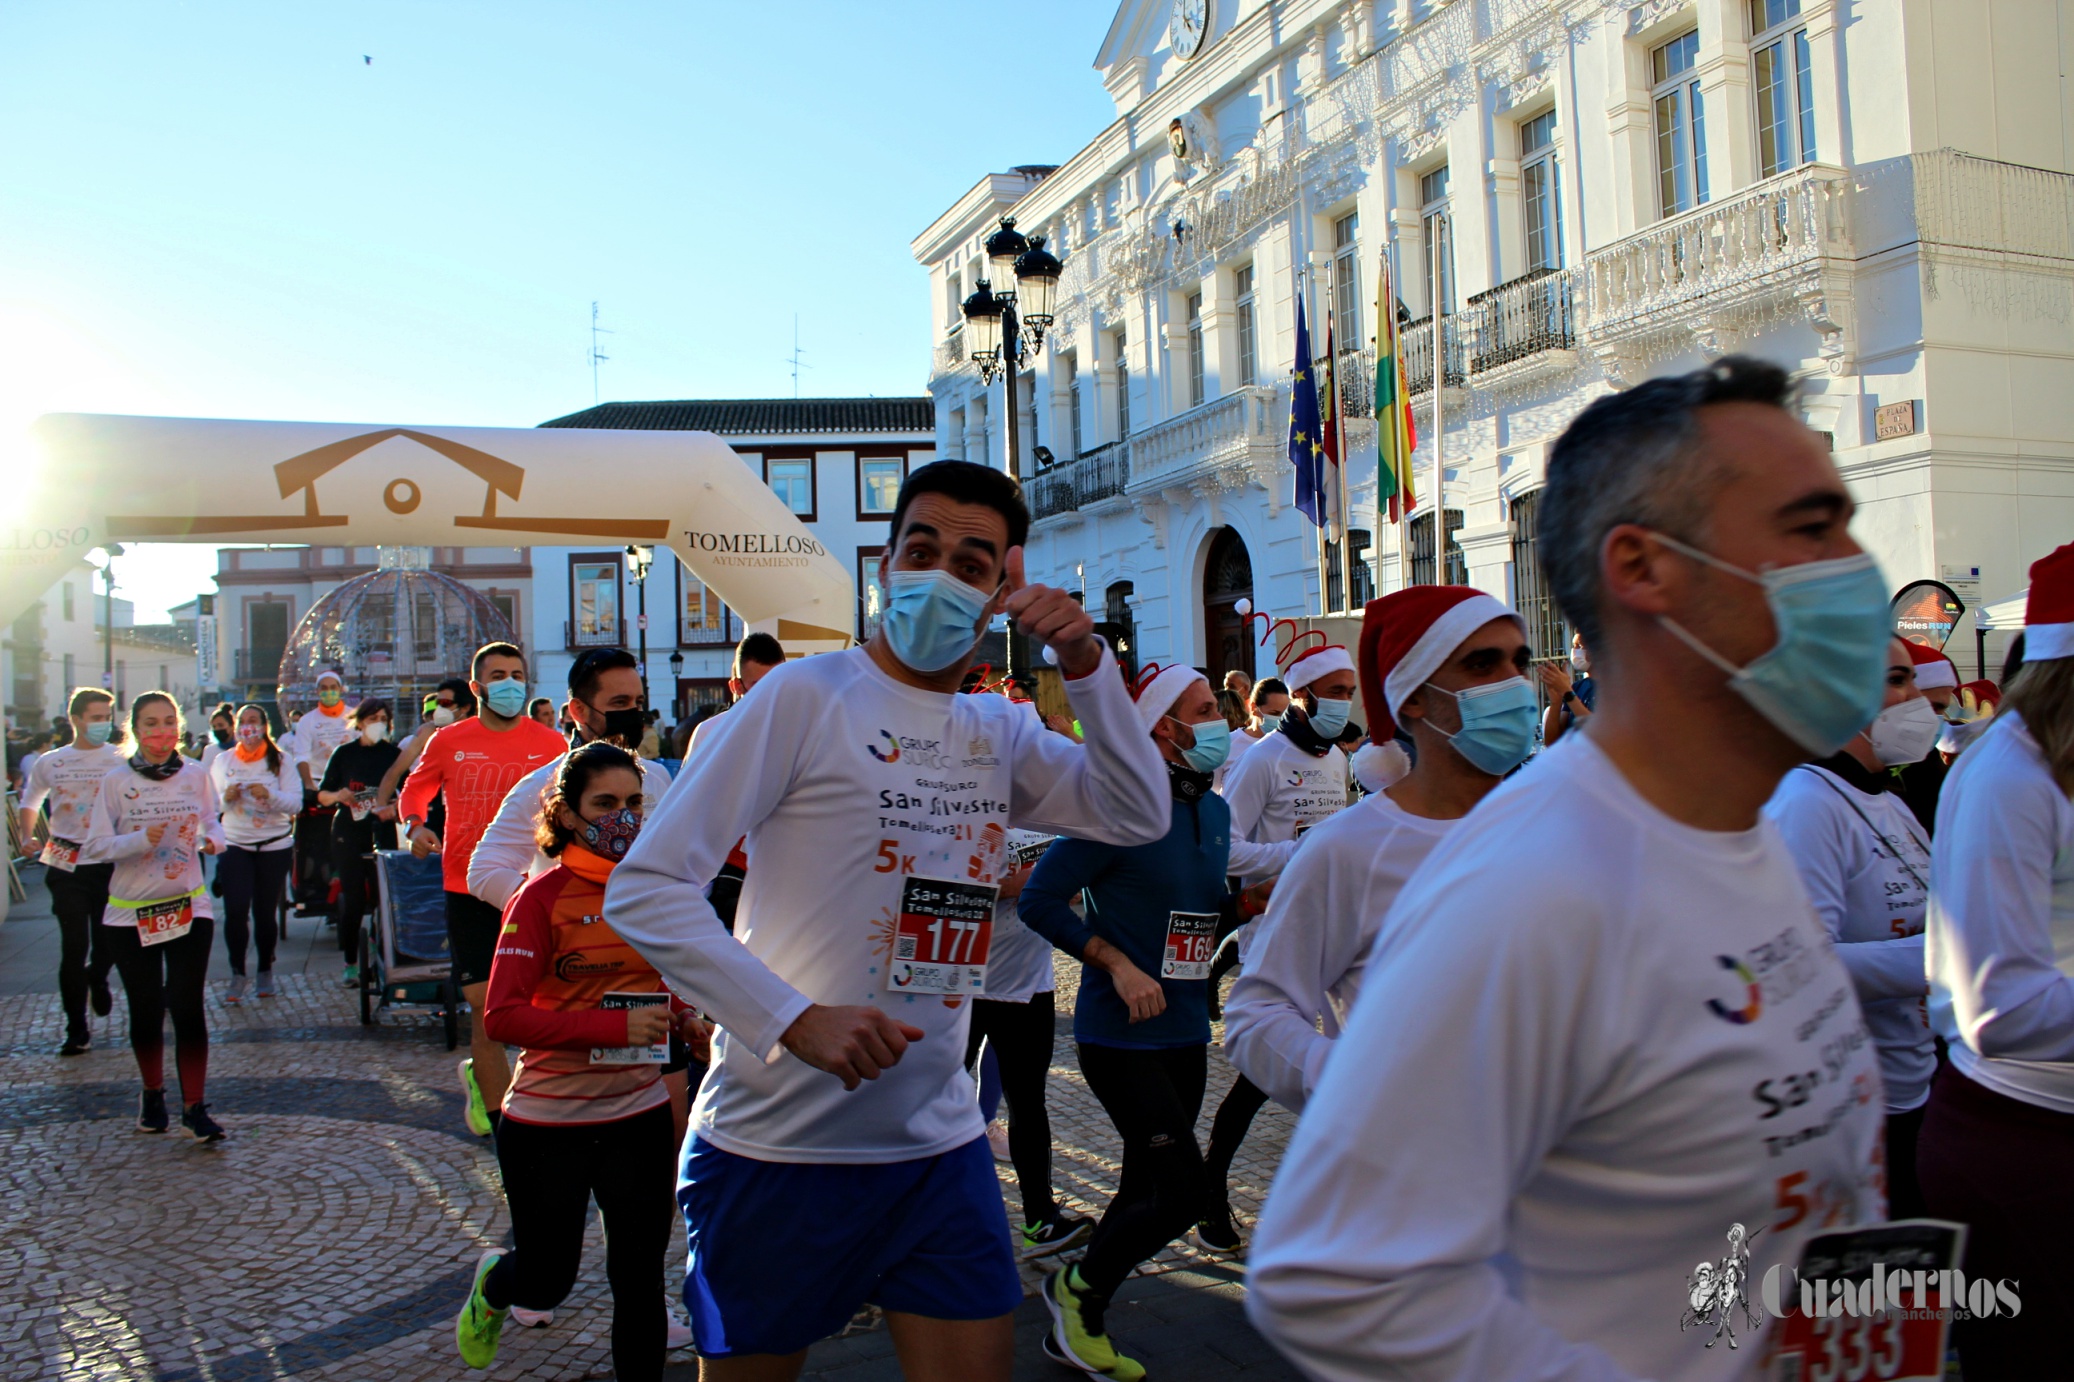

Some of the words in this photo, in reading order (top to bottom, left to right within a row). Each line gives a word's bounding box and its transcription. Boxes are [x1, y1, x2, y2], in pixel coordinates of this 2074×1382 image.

[1886, 405, 1908, 416] PLAZA
[1880, 422, 1908, 437] ESPAÑA
[684, 530, 825, 557] TOMELLOSO
[712, 555, 809, 568] AYUNTAMIENTO
[1897, 620, 1928, 630] Pieles
[1928, 621, 1952, 630] RUN
[1302, 770, 1323, 778] GRUPO
[1182, 782, 1196, 795] KIA
[879, 789, 922, 809] San
[929, 796, 1009, 816] Silvestre
[1294, 798, 1315, 808] San
[1883, 881, 1910, 896] San
[909, 888, 941, 902] San
[945, 892, 993, 908] Silvestre
[155, 913, 180, 931] 82
[1173, 919, 1192, 928] San
[927, 918, 981, 963] 177
[514, 947, 534, 958] RUN
[1183, 936, 1212, 962] 169
[602, 1000, 622, 1009] San
[1809, 1310, 1905, 1382] 333
